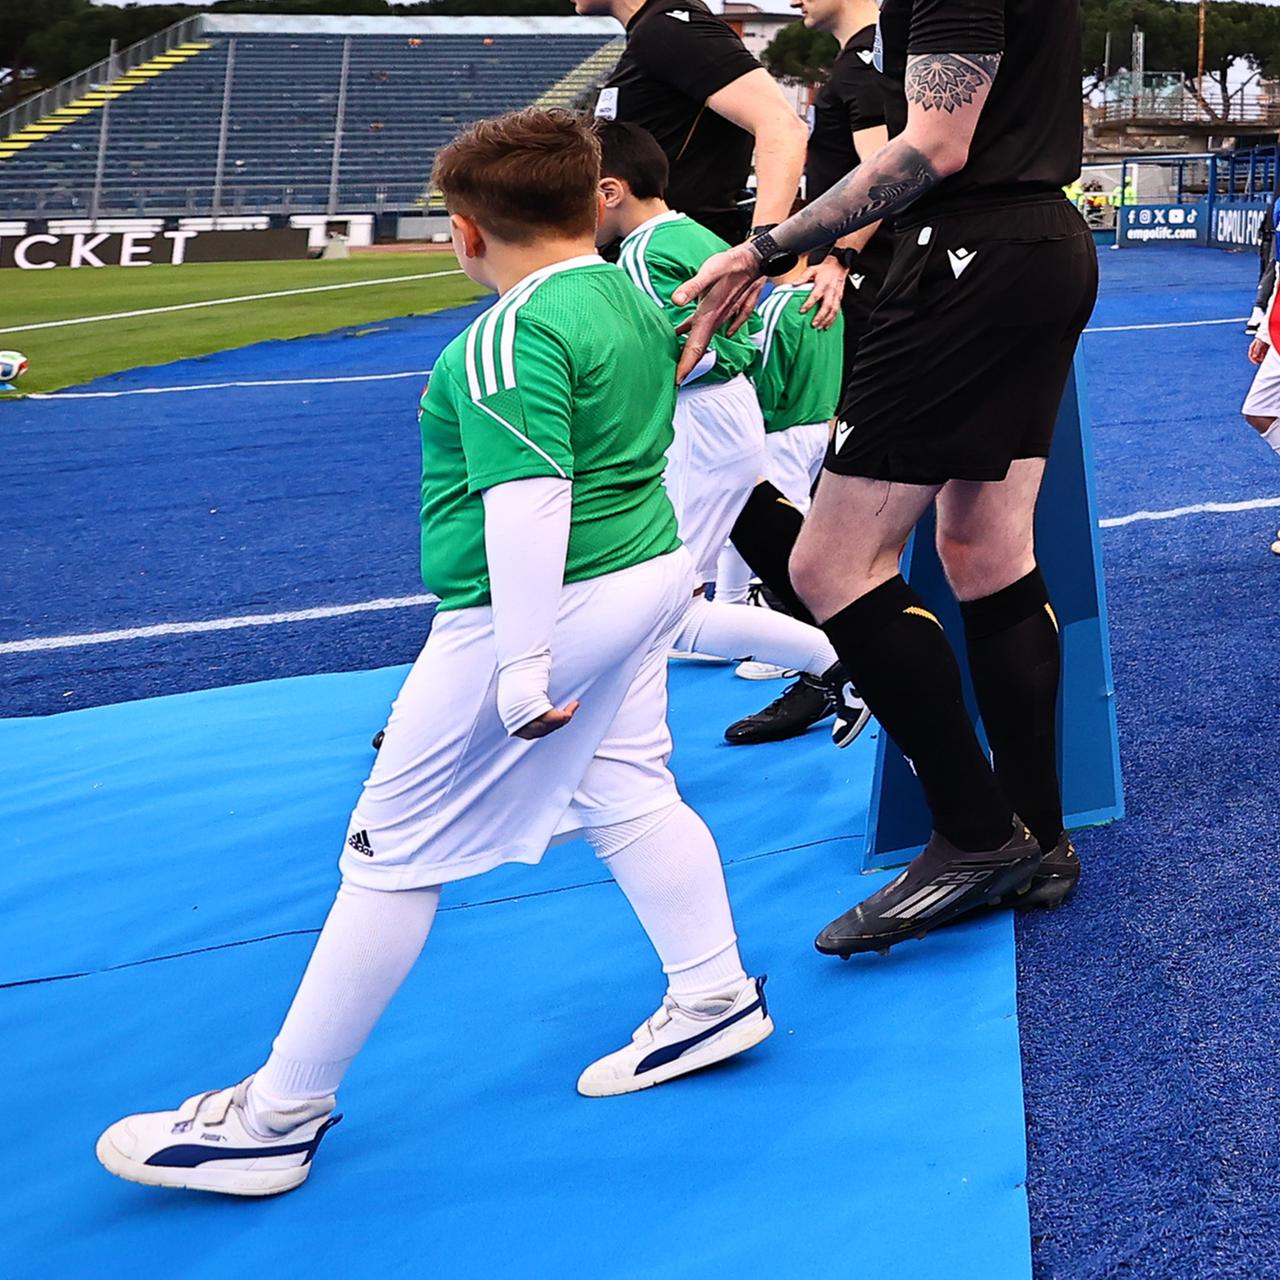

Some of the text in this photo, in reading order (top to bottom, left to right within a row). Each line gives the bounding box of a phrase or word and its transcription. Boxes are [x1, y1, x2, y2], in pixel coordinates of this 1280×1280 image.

[1127, 226, 1197, 241] empolifc.com
[14, 231, 199, 270] CKET
[929, 869, 995, 885] F50
